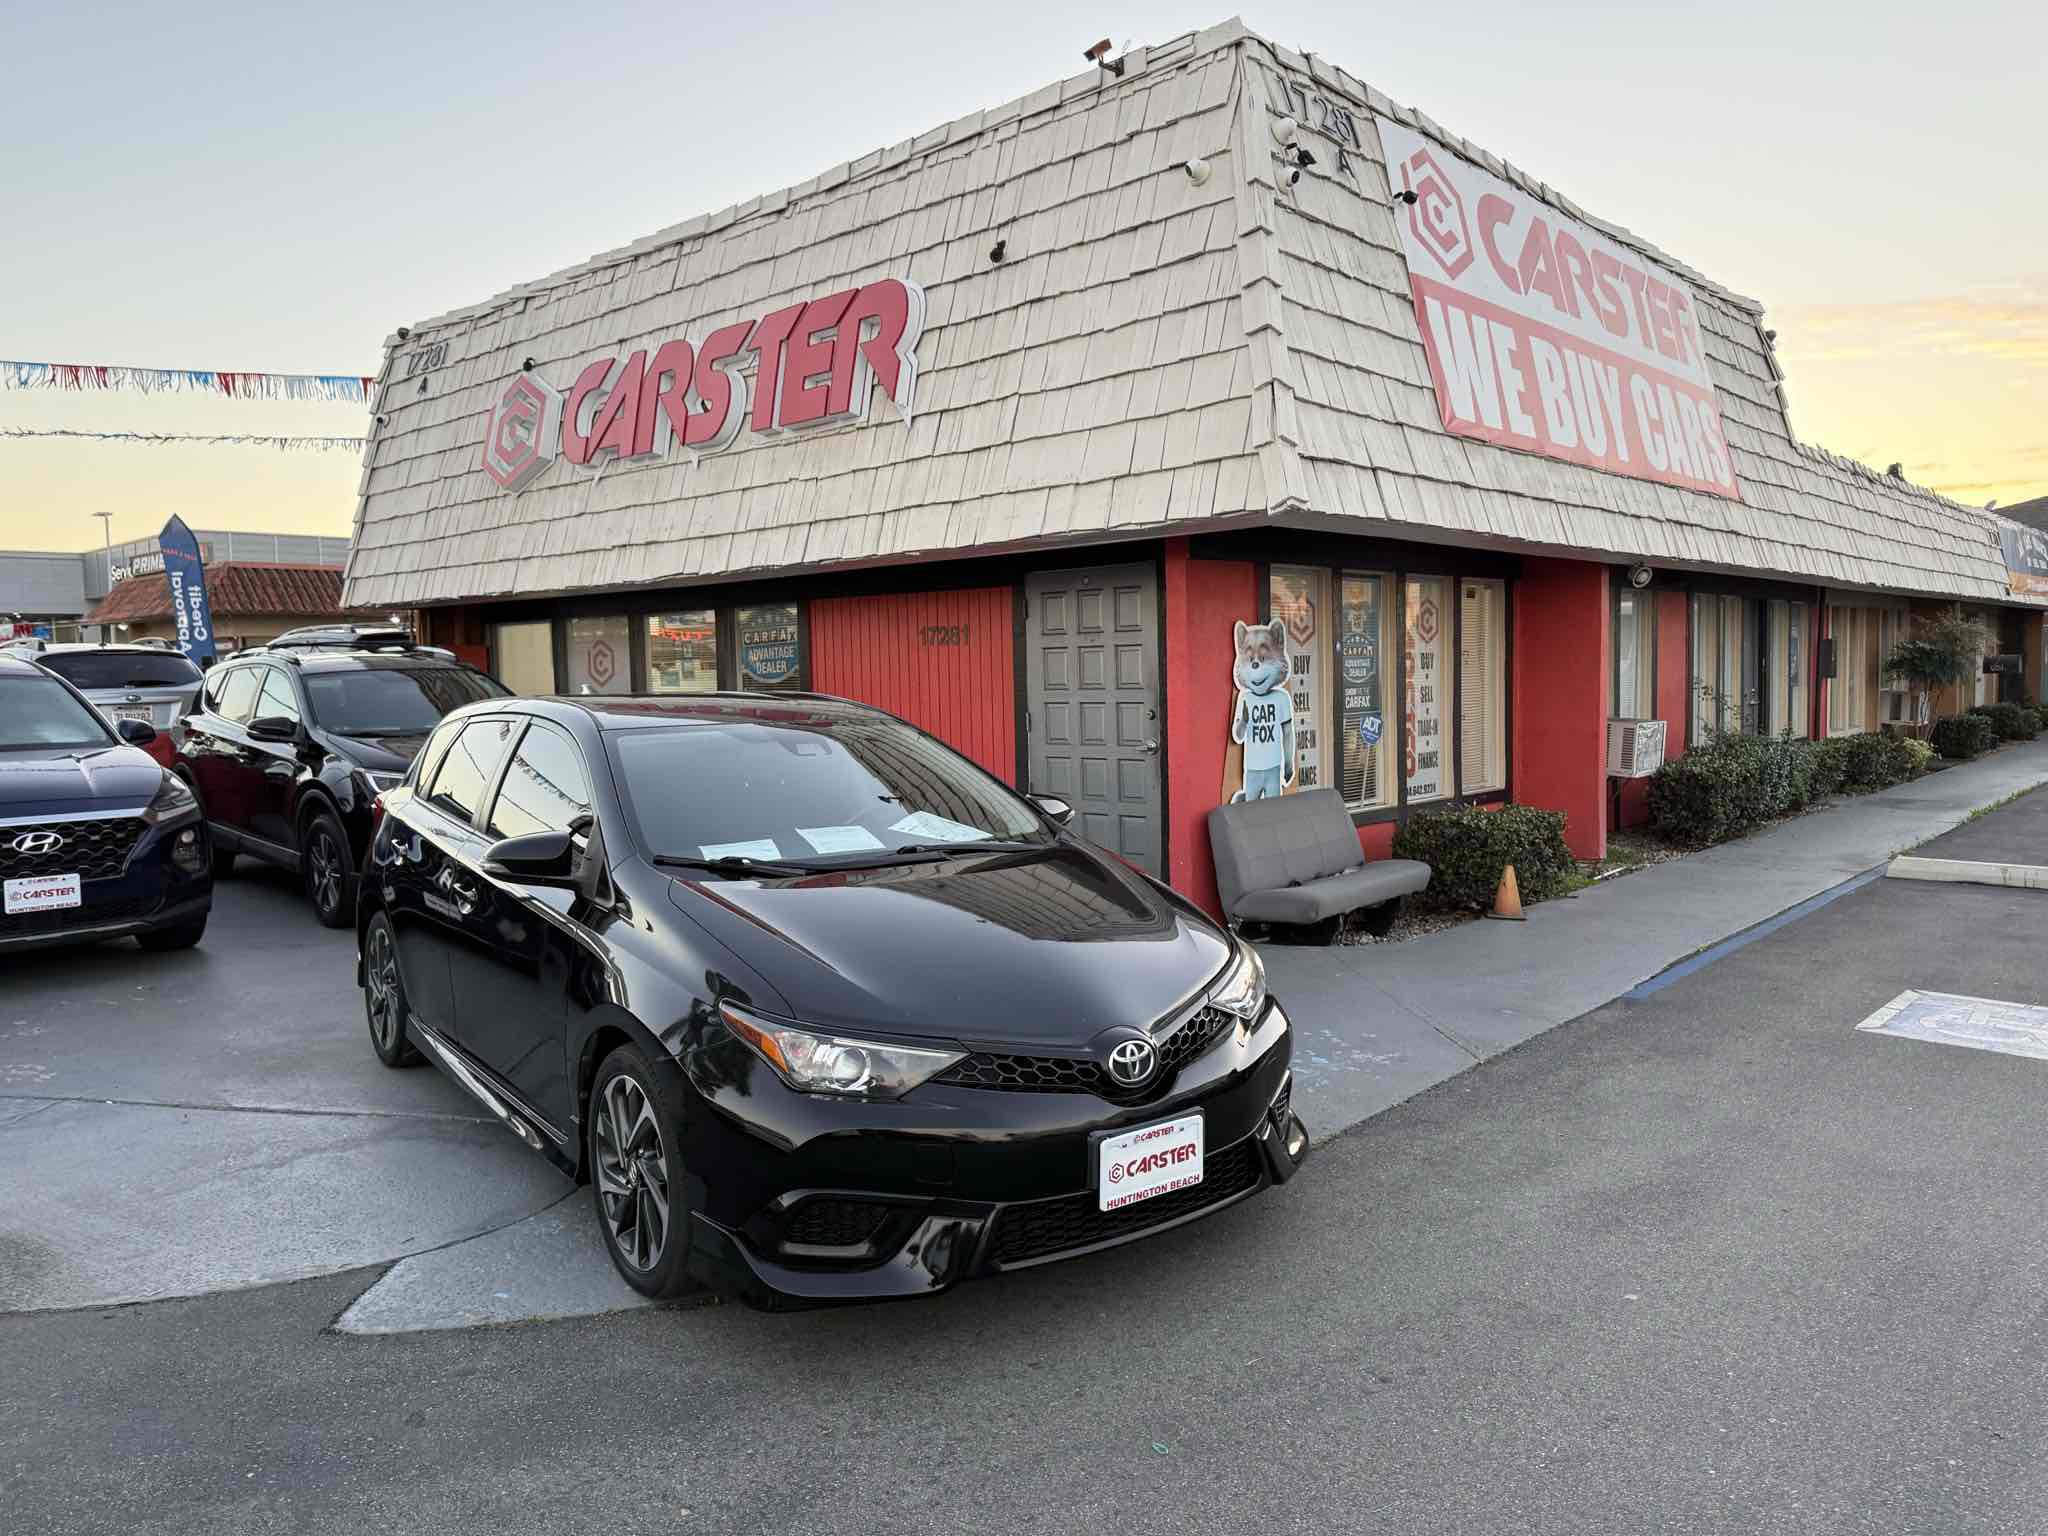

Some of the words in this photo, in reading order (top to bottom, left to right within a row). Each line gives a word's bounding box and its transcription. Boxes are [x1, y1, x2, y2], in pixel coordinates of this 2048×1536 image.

[1336, 148, 1356, 178] A
[1477, 193, 1700, 369] CARSTER
[562, 279, 924, 466] CARSTER
[1424, 296, 1535, 438] WE
[1529, 335, 1630, 463] BUY
[1630, 373, 1731, 490] CARS
[744, 627, 797, 644] CARFAX
[747, 645, 794, 663] ADVANTAGE
[1420, 653, 1434, 670] BUY
[755, 660, 787, 674] DEALER
[1294, 655, 1310, 674] BUY
[1294, 692, 1310, 712] SELL
[1420, 686, 1433, 703] SELL
[1251, 704, 1276, 724] CAR
[1252, 724, 1275, 743] FOX
[1363, 717, 1382, 733] ADT
[1418, 719, 1438, 737] TRADE-IN
[1418, 751, 1438, 769] FINANCE
[23, 887, 75, 900] CARSTER
[1141, 1126, 1174, 1141] CARSTER
[1126, 1143, 1196, 1177] CARSTER
[1106, 1184, 1168, 1210] HUNTINGTON
[1170, 1174, 1200, 1190] BEACH
